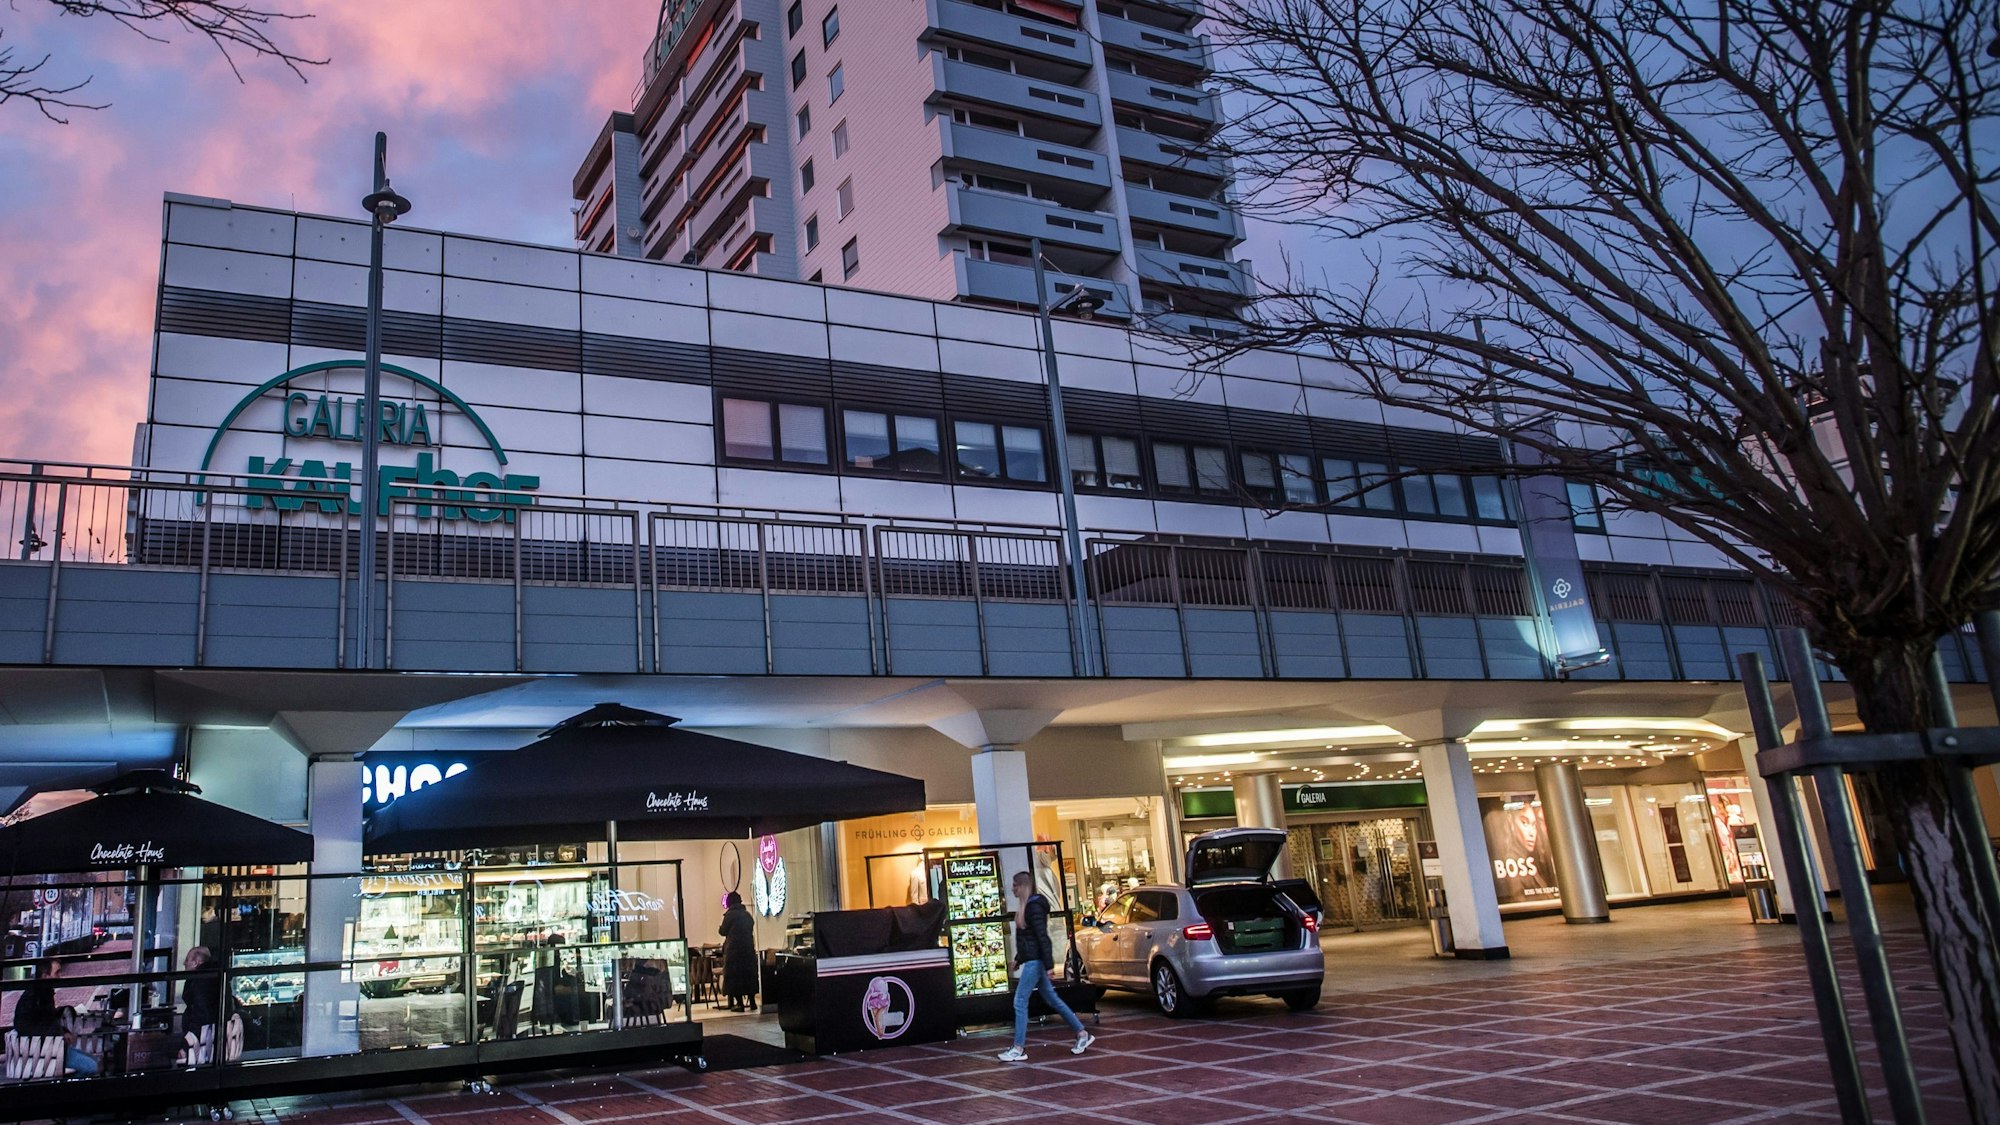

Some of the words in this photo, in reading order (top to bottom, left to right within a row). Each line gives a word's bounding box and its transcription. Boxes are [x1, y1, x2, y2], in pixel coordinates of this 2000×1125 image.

[284, 392, 432, 447] GALERIA
[646, 791, 682, 808] Chocolate
[683, 789, 708, 811] Haus
[1300, 792, 1327, 803] GALERIA
[855, 829, 908, 840] FRÜHLING
[928, 826, 974, 837] GALERIA
[90, 842, 134, 861] Chocolate
[135, 840, 165, 862] Haus
[1494, 856, 1537, 879] BOSS
